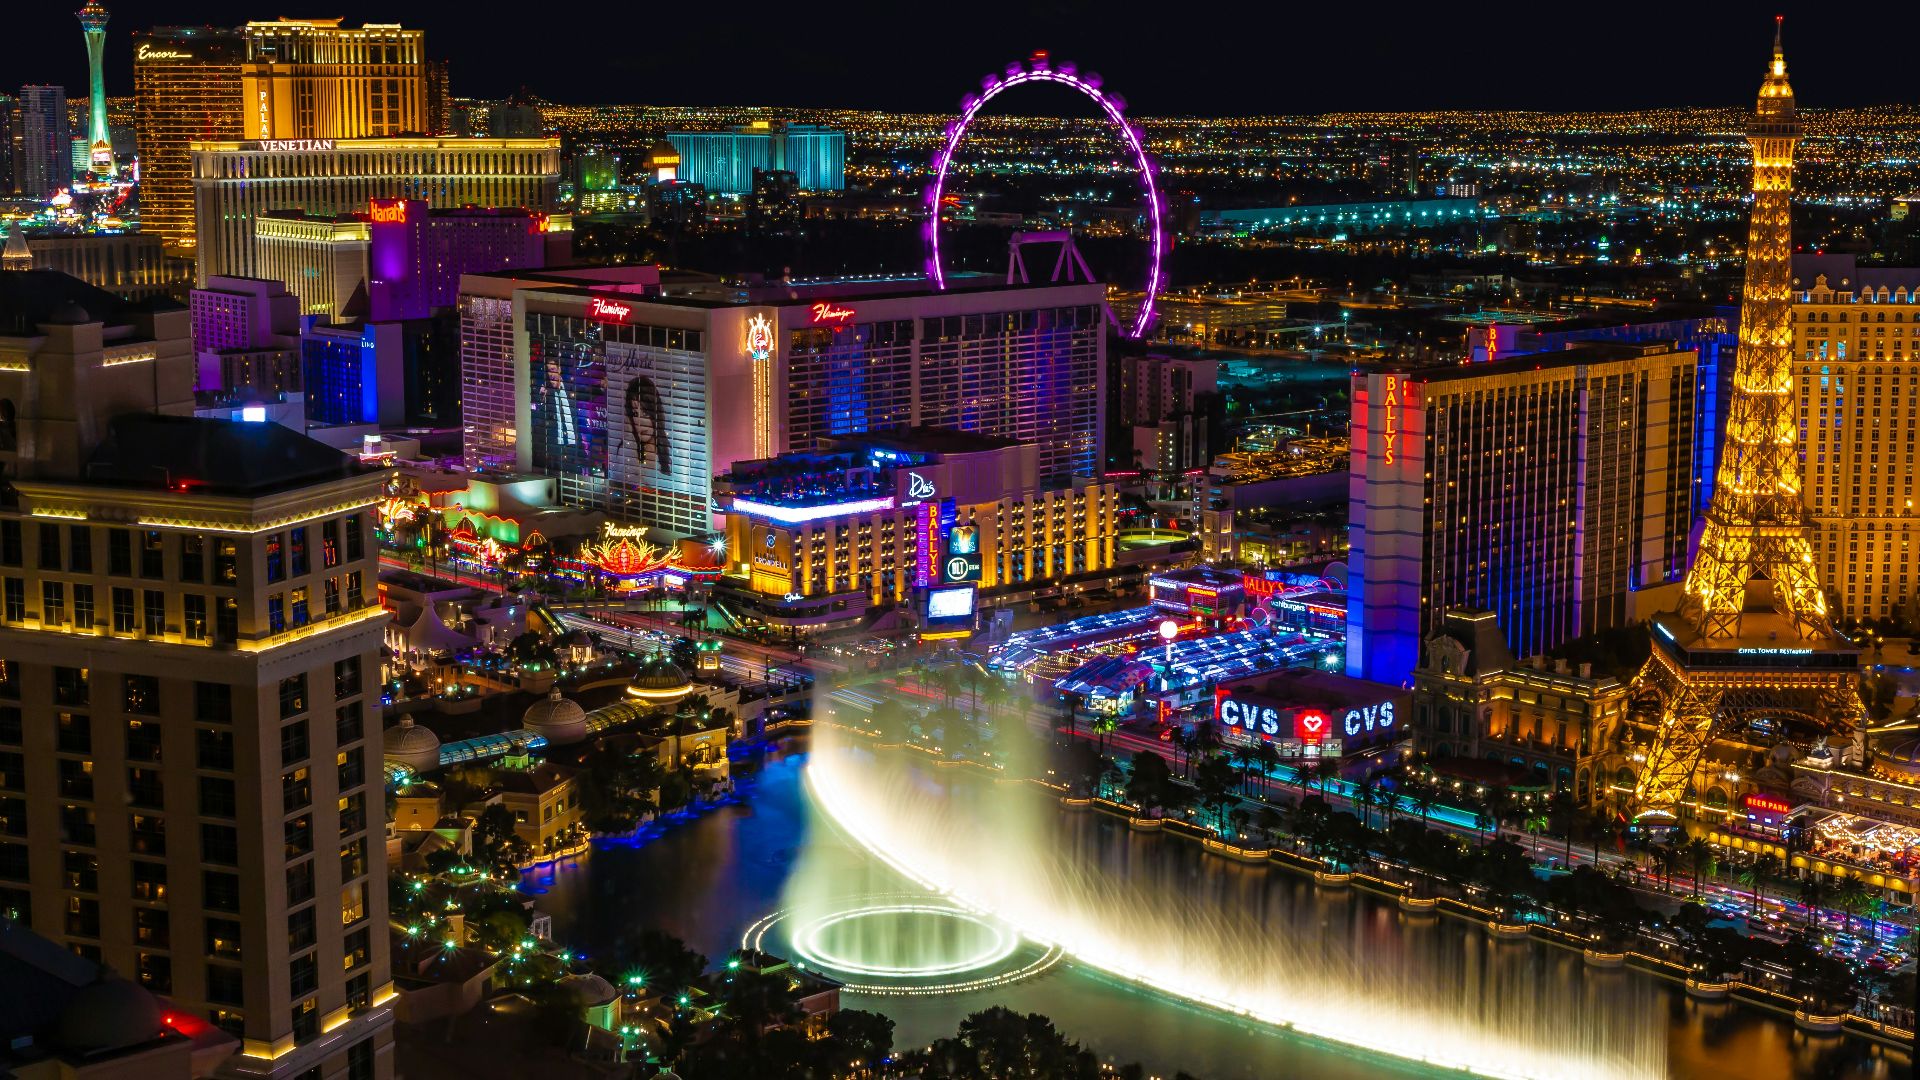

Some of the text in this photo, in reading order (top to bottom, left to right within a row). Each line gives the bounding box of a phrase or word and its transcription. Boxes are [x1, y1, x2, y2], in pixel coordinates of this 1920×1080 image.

[138, 44, 192, 60] Encore
[259, 140, 333, 151] VENETIAN
[593, 298, 630, 321] Flamingo
[812, 303, 855, 322] Flamingo
[1384, 376, 1397, 465] BALLYS
[604, 521, 649, 542] Flamingo
[928, 505, 939, 577] BALLYS
[951, 561, 965, 575] BLT
[1243, 575, 1284, 597] BALLY'S
[1221, 700, 1279, 735] CVS
[1344, 701, 1394, 736] CVS
[1747, 797, 1788, 813] BEER PARK
